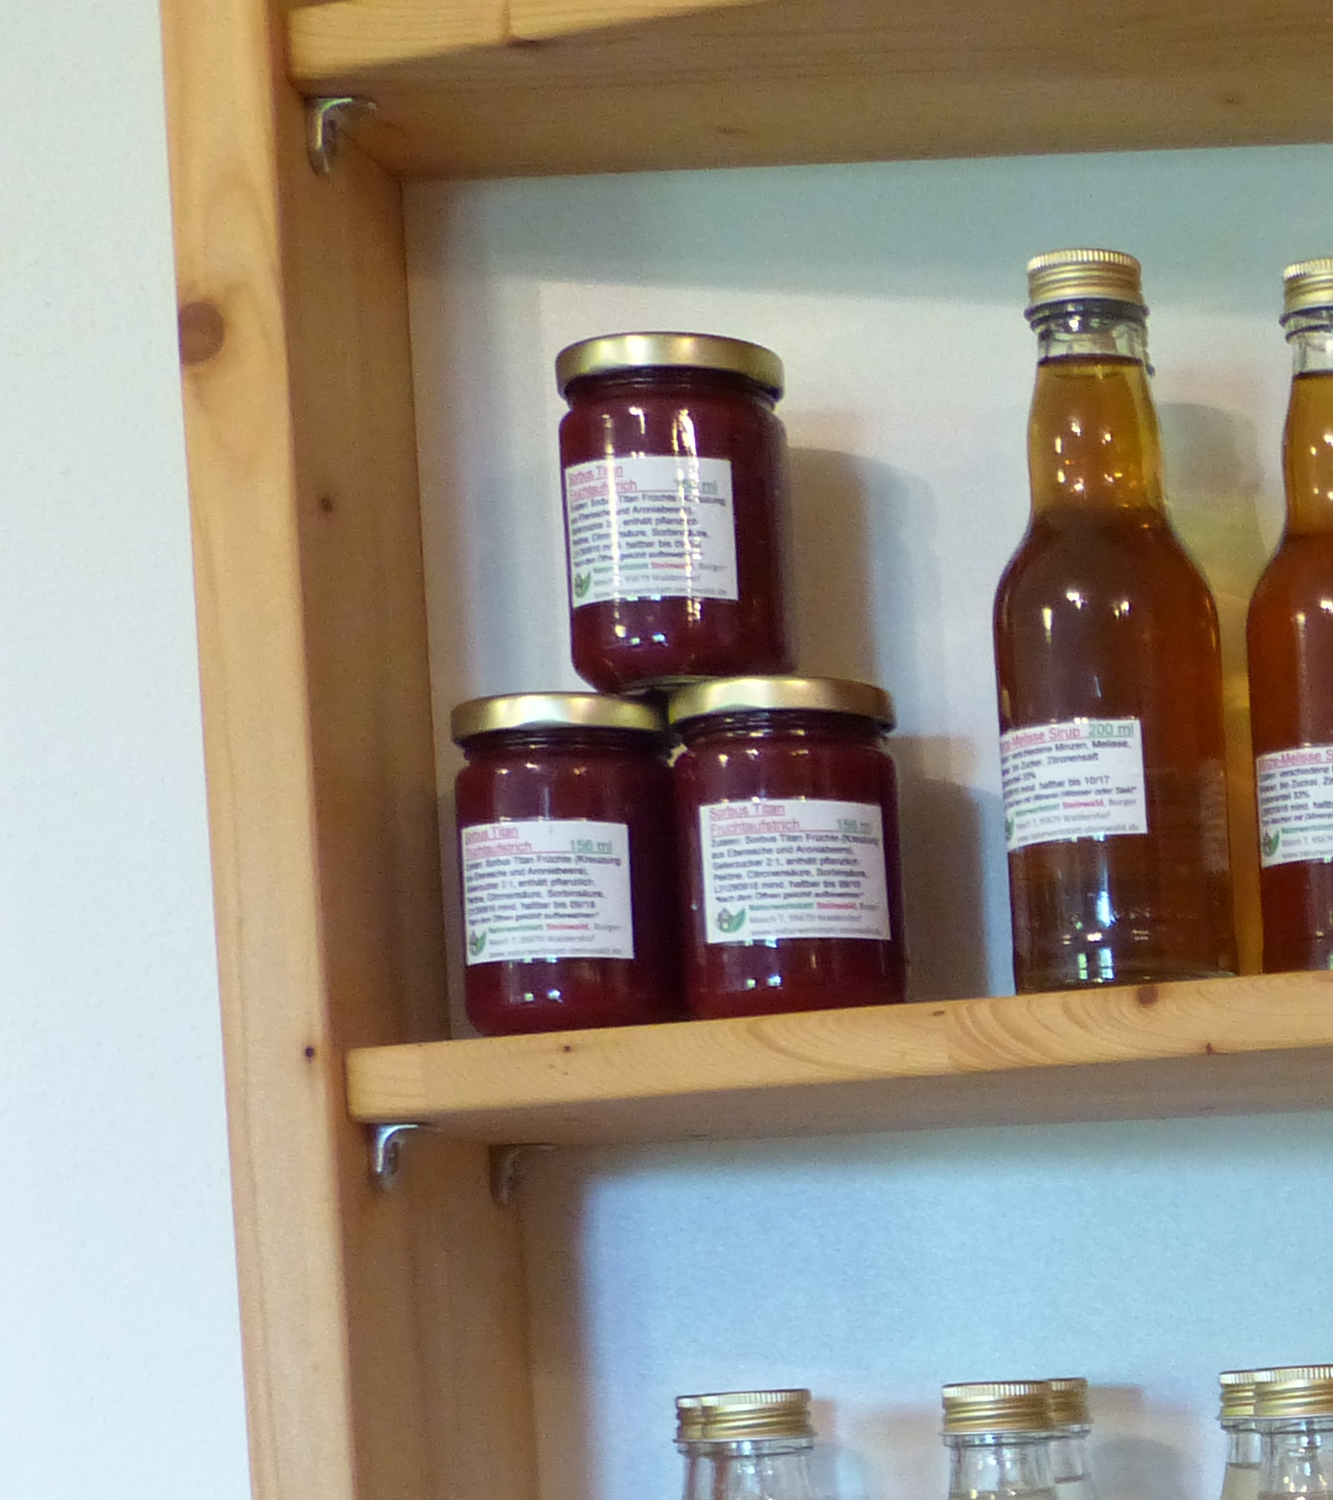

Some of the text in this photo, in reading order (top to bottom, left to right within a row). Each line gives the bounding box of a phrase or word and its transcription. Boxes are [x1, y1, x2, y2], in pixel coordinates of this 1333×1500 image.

[1049, 723, 1134, 740] Sirup 200 ml
[571, 840, 612, 851] 156 ml
